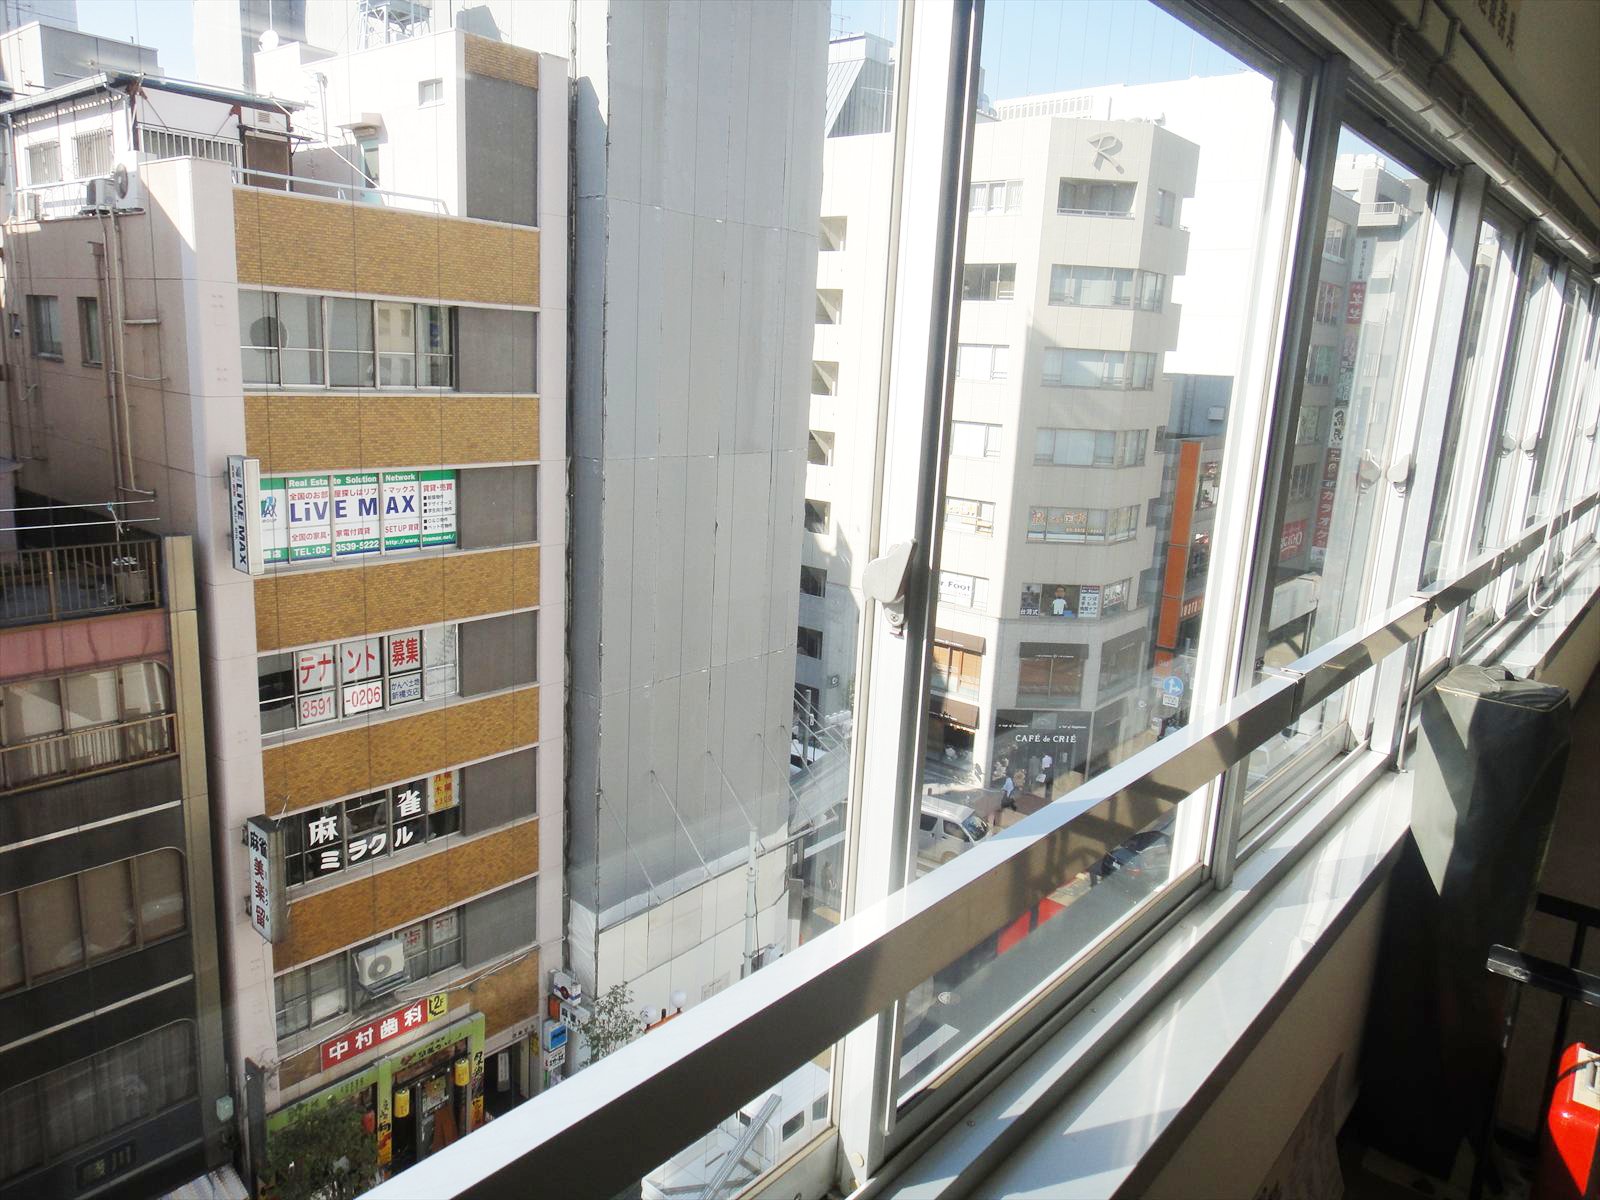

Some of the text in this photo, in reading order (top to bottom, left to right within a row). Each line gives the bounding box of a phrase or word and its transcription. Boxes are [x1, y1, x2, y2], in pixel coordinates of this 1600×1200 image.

[289, 479, 307, 487] Real
[345, 475, 377, 484] Solution
[385, 473, 416, 481] Network
[358, 494, 415, 517] MAX
[1015, 733, 1041, 743] CAFÉ
[1052, 734, 1077, 743] CRIÉ
[250, 831, 268, 860] 麻雀
[320, 826, 414, 870] ミラクル
[328, 1004, 423, 1061] 中村歯科
